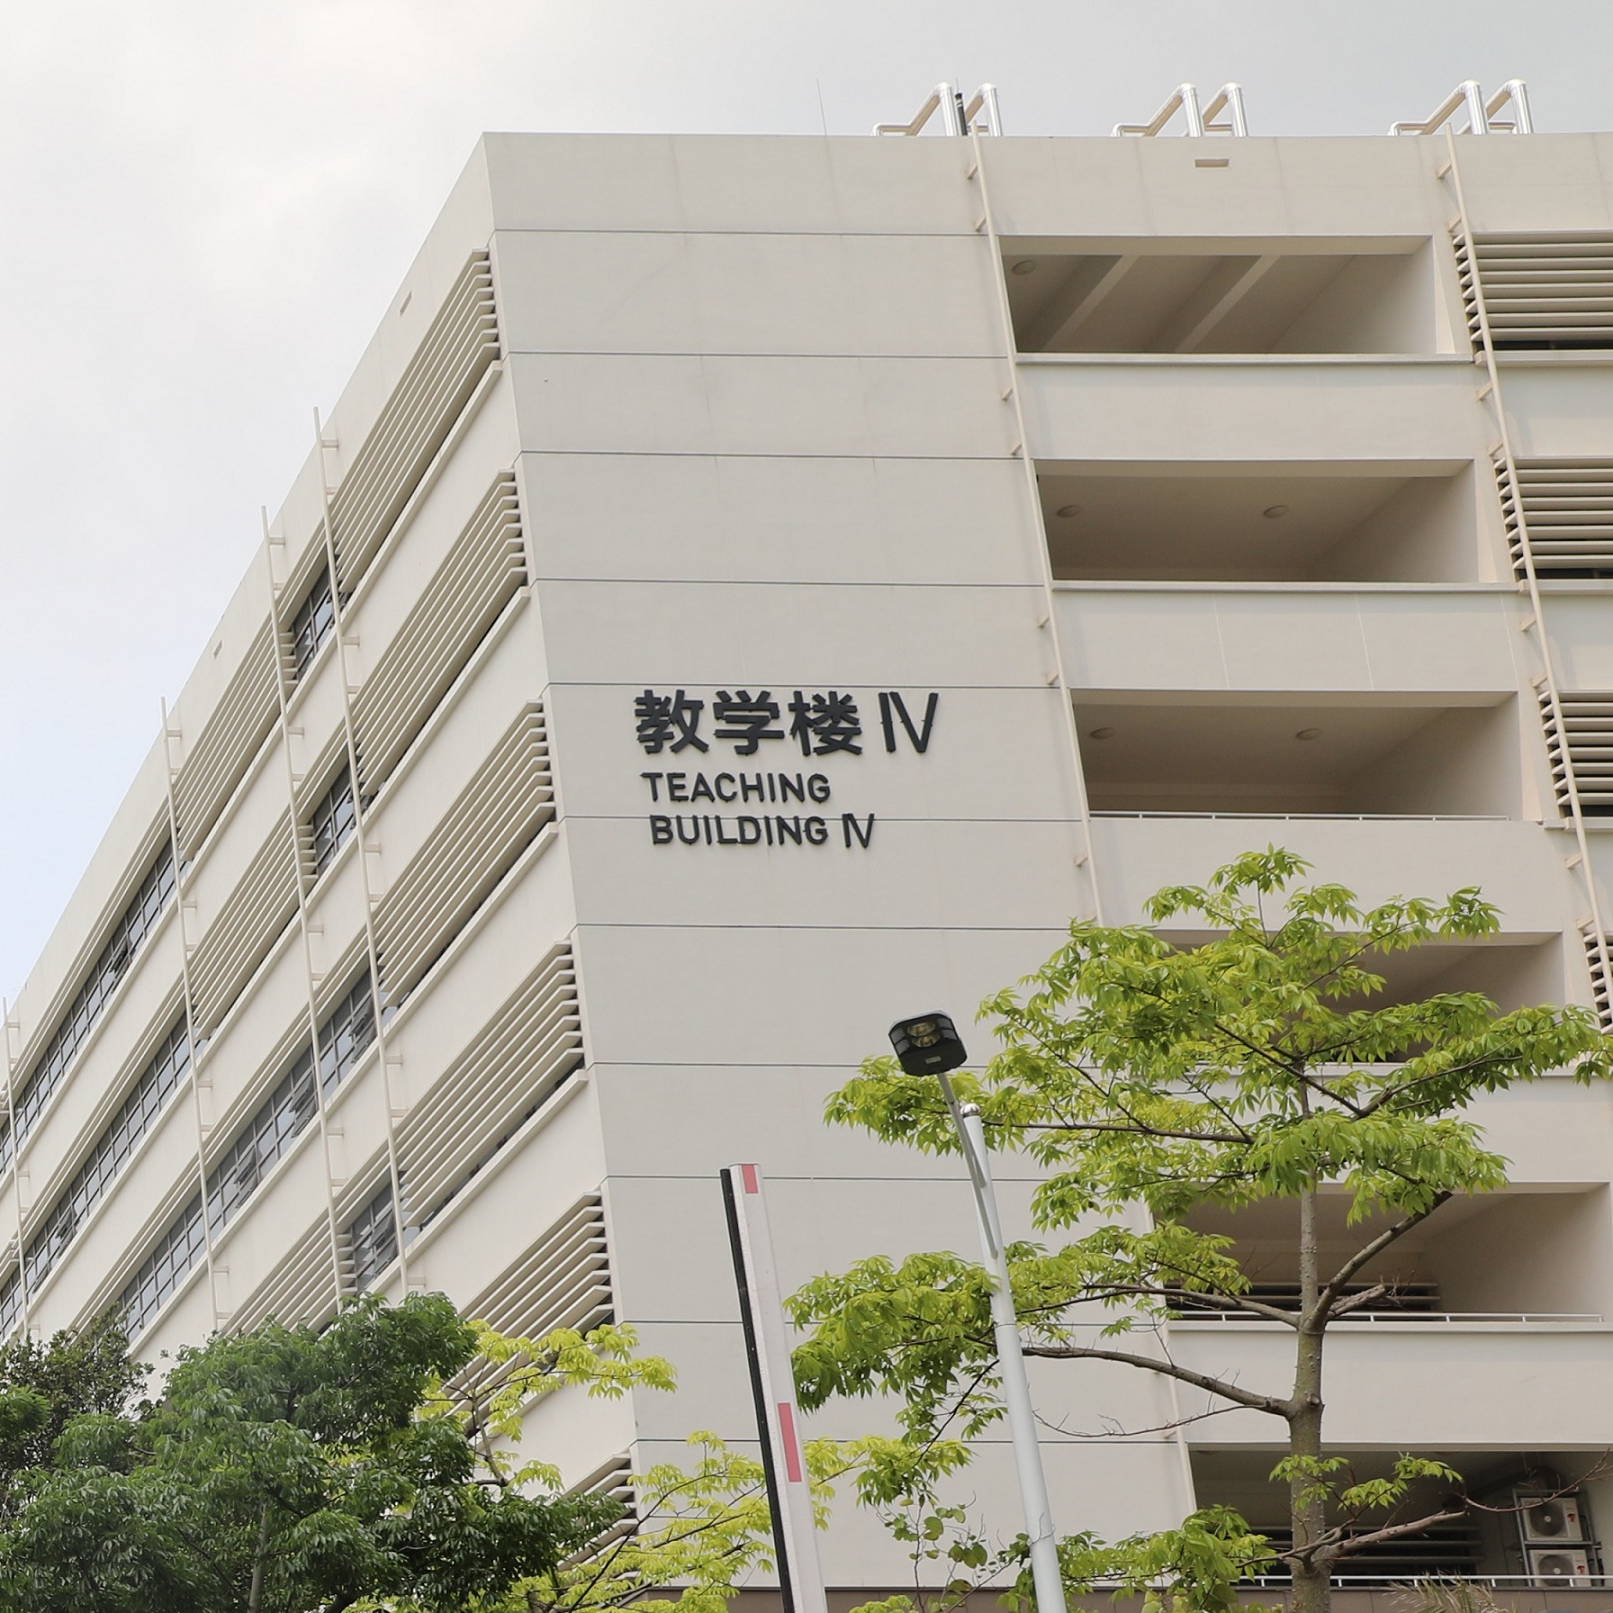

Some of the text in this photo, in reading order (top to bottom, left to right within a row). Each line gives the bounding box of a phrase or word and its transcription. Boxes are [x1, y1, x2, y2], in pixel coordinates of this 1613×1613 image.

[634, 689, 863, 756] 教学楼
[640, 772, 831, 803] TEACHING
[649, 814, 828, 846] BUILDING
